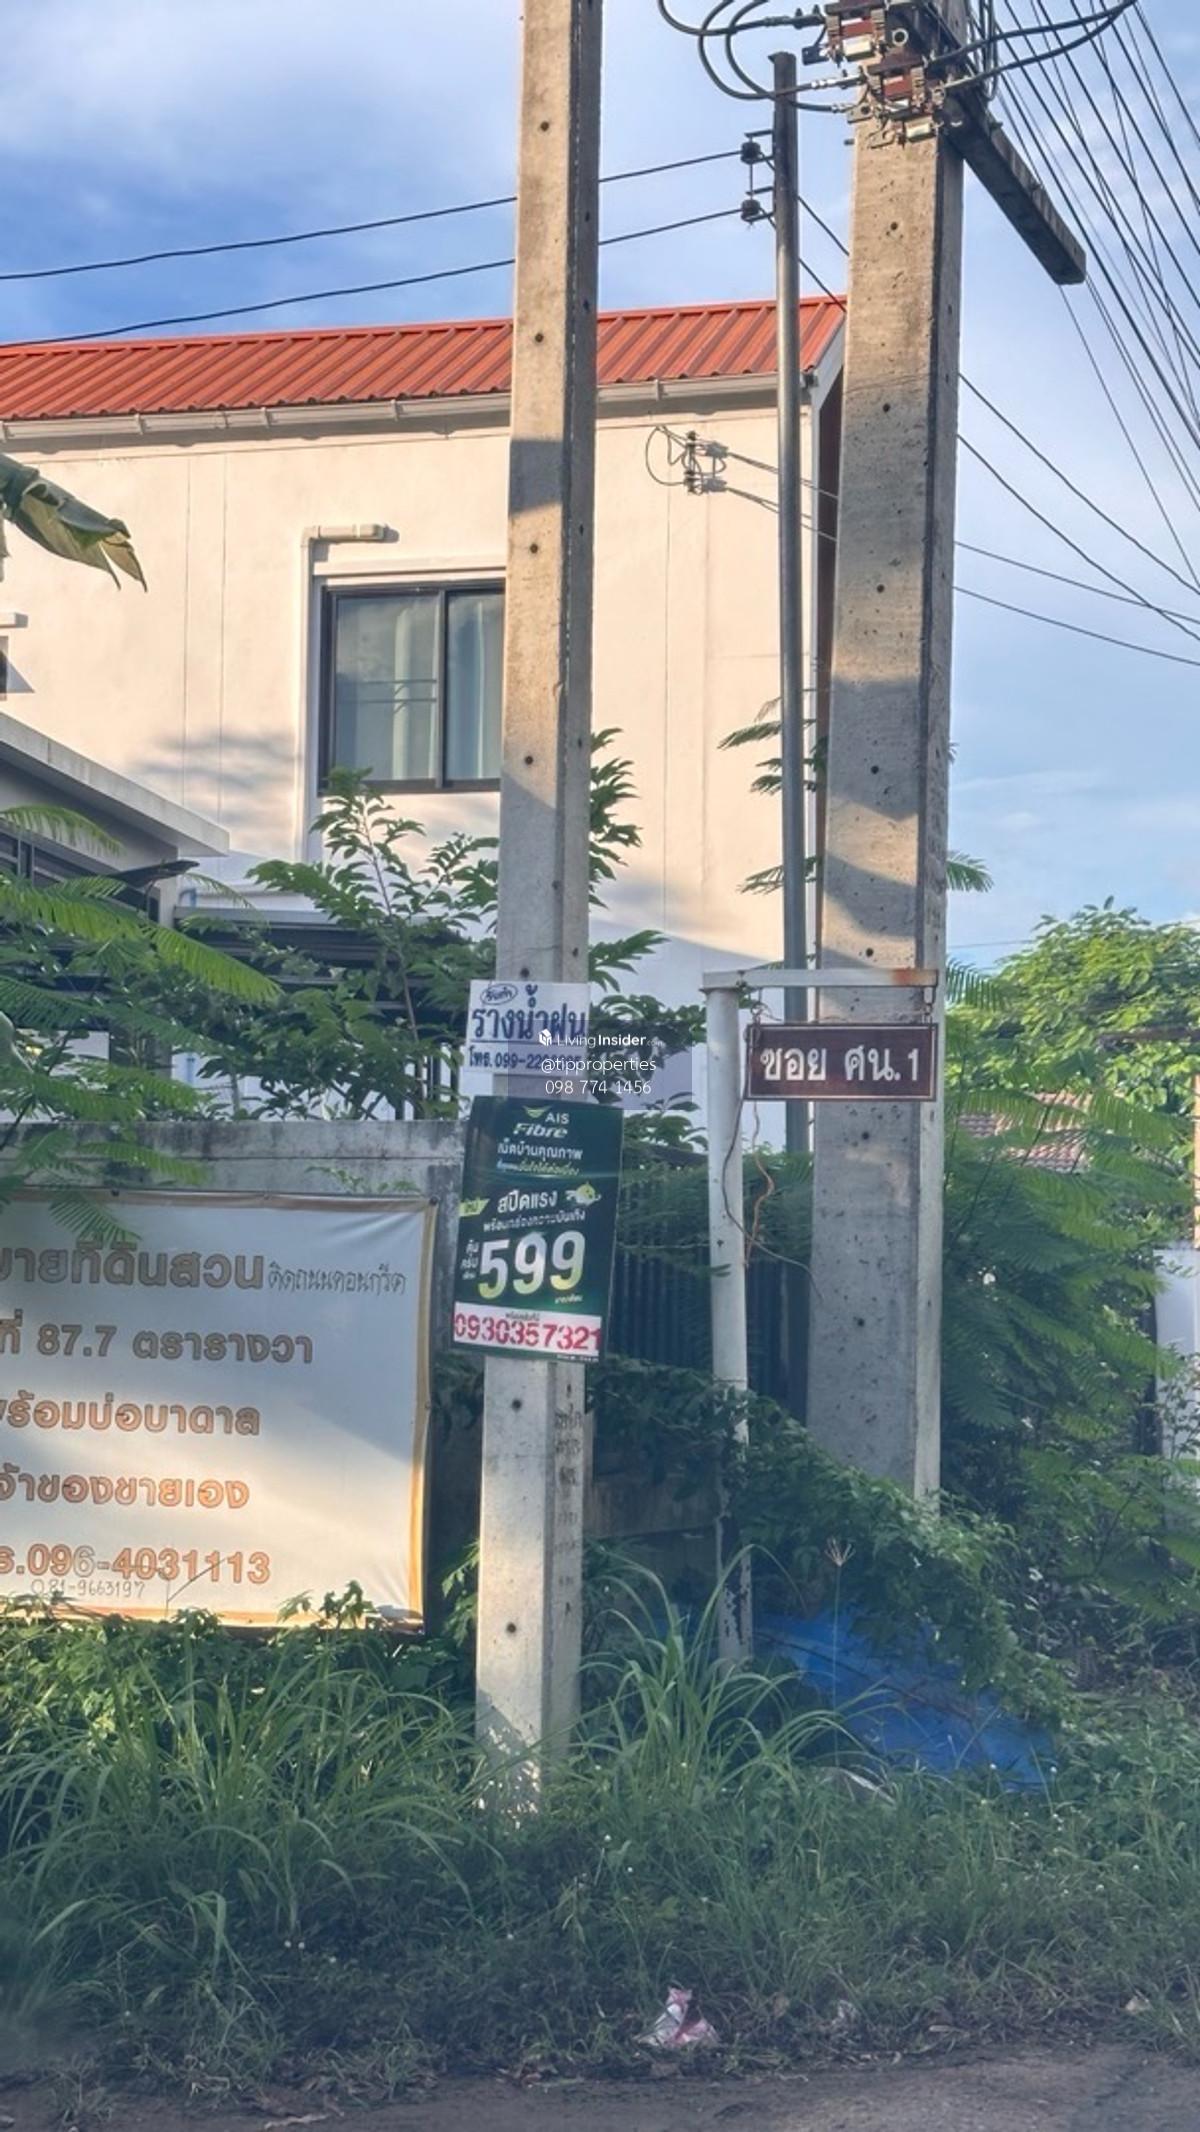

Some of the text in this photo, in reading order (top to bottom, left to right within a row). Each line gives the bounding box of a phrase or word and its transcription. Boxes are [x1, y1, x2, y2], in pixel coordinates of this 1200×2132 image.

[760, 1047, 826, 1081] ซอย
[513, 1123, 568, 1138] Fibre
[545, 1112, 569, 1124] AIS
[478, 1230, 585, 1299] 599
[37, 1324, 118, 1357] 87.7
[454, 1313, 601, 1350] 0930357321
[0, 1390, 261, 1434] ร้อมบ่อบาดาล
